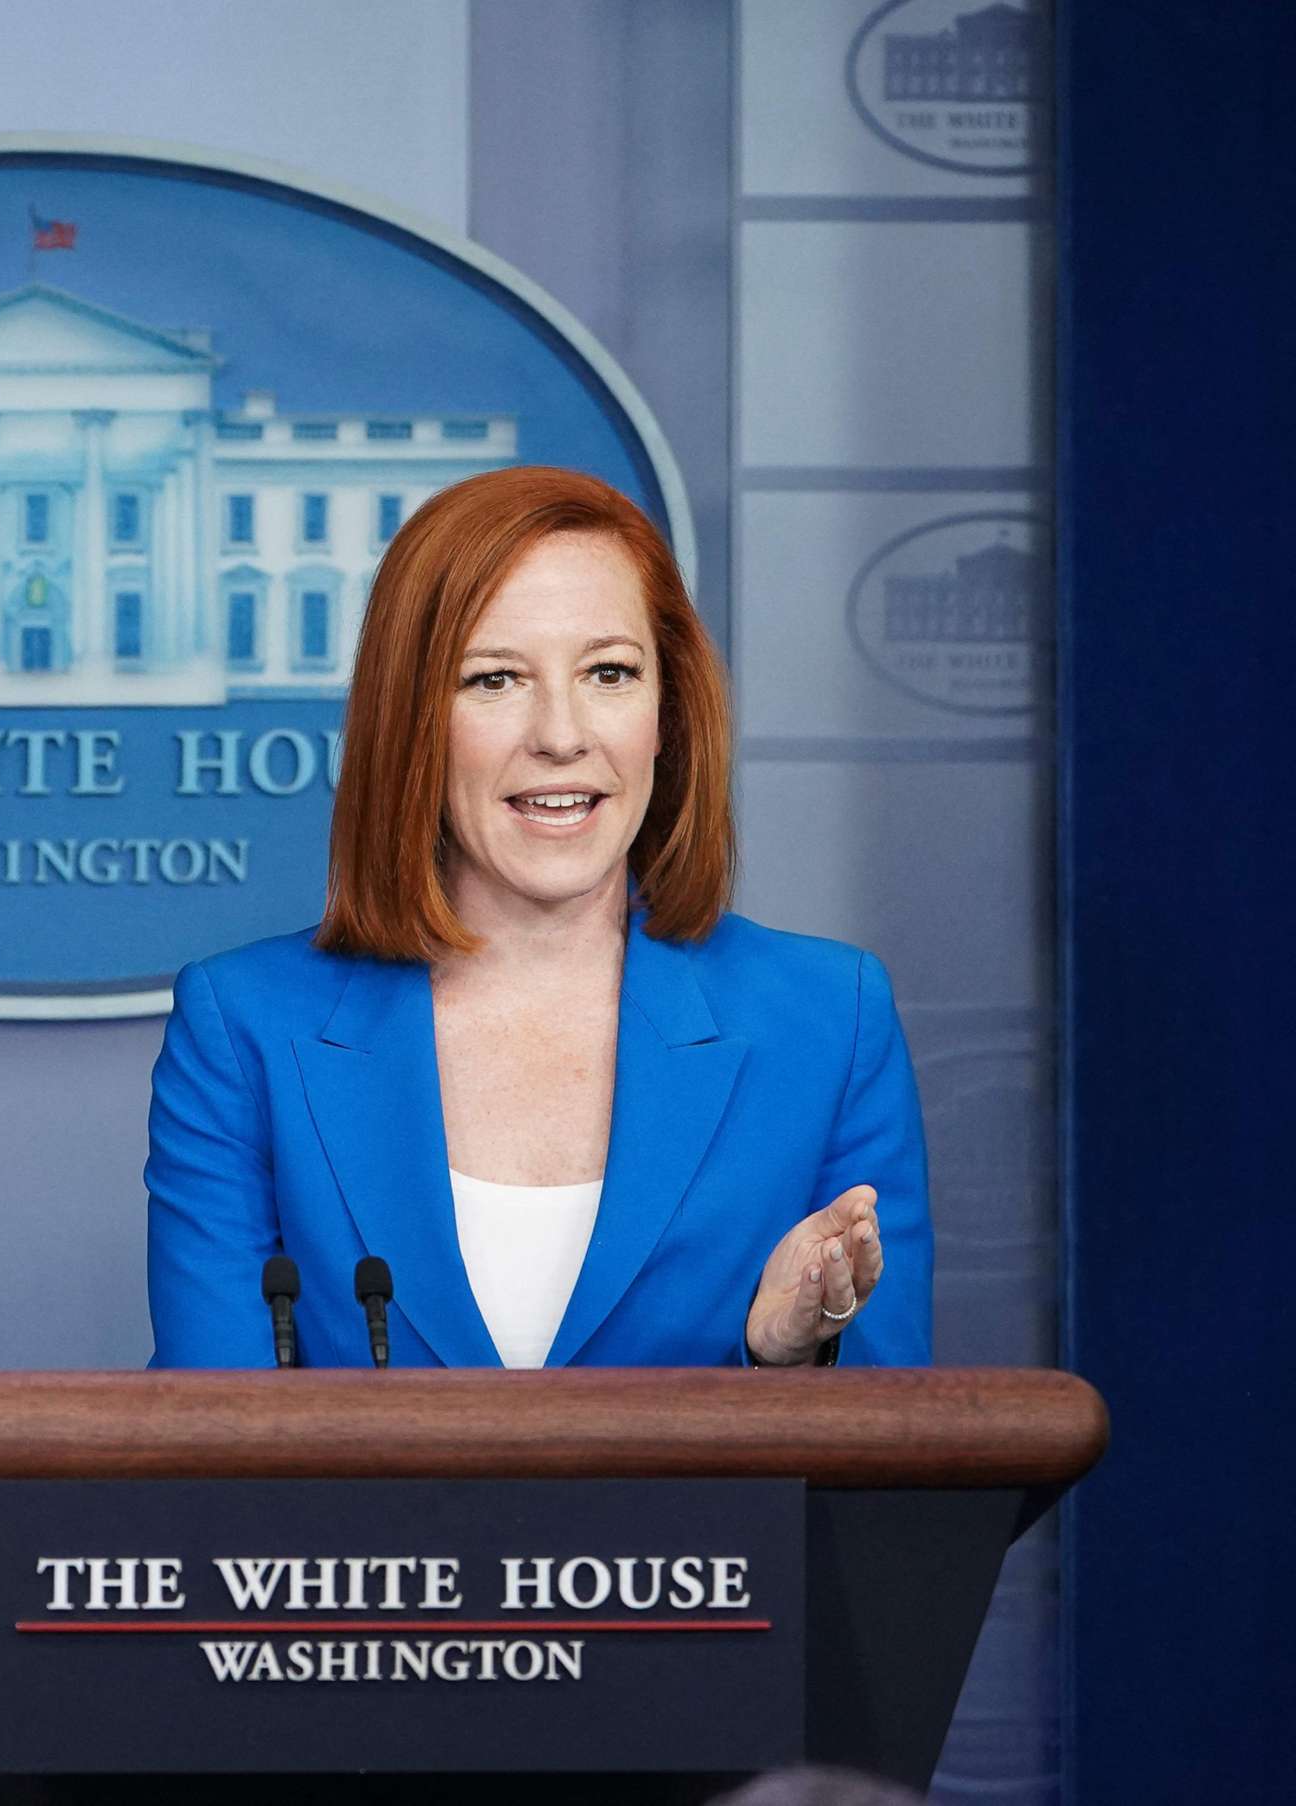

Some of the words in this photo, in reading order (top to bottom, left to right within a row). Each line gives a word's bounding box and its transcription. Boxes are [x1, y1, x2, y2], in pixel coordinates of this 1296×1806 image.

[36, 1556, 186, 1611] THE
[213, 1556, 463, 1611] WHITE
[501, 1556, 752, 1611] HOUSE
[200, 1640, 585, 1682] WASHINGTON
